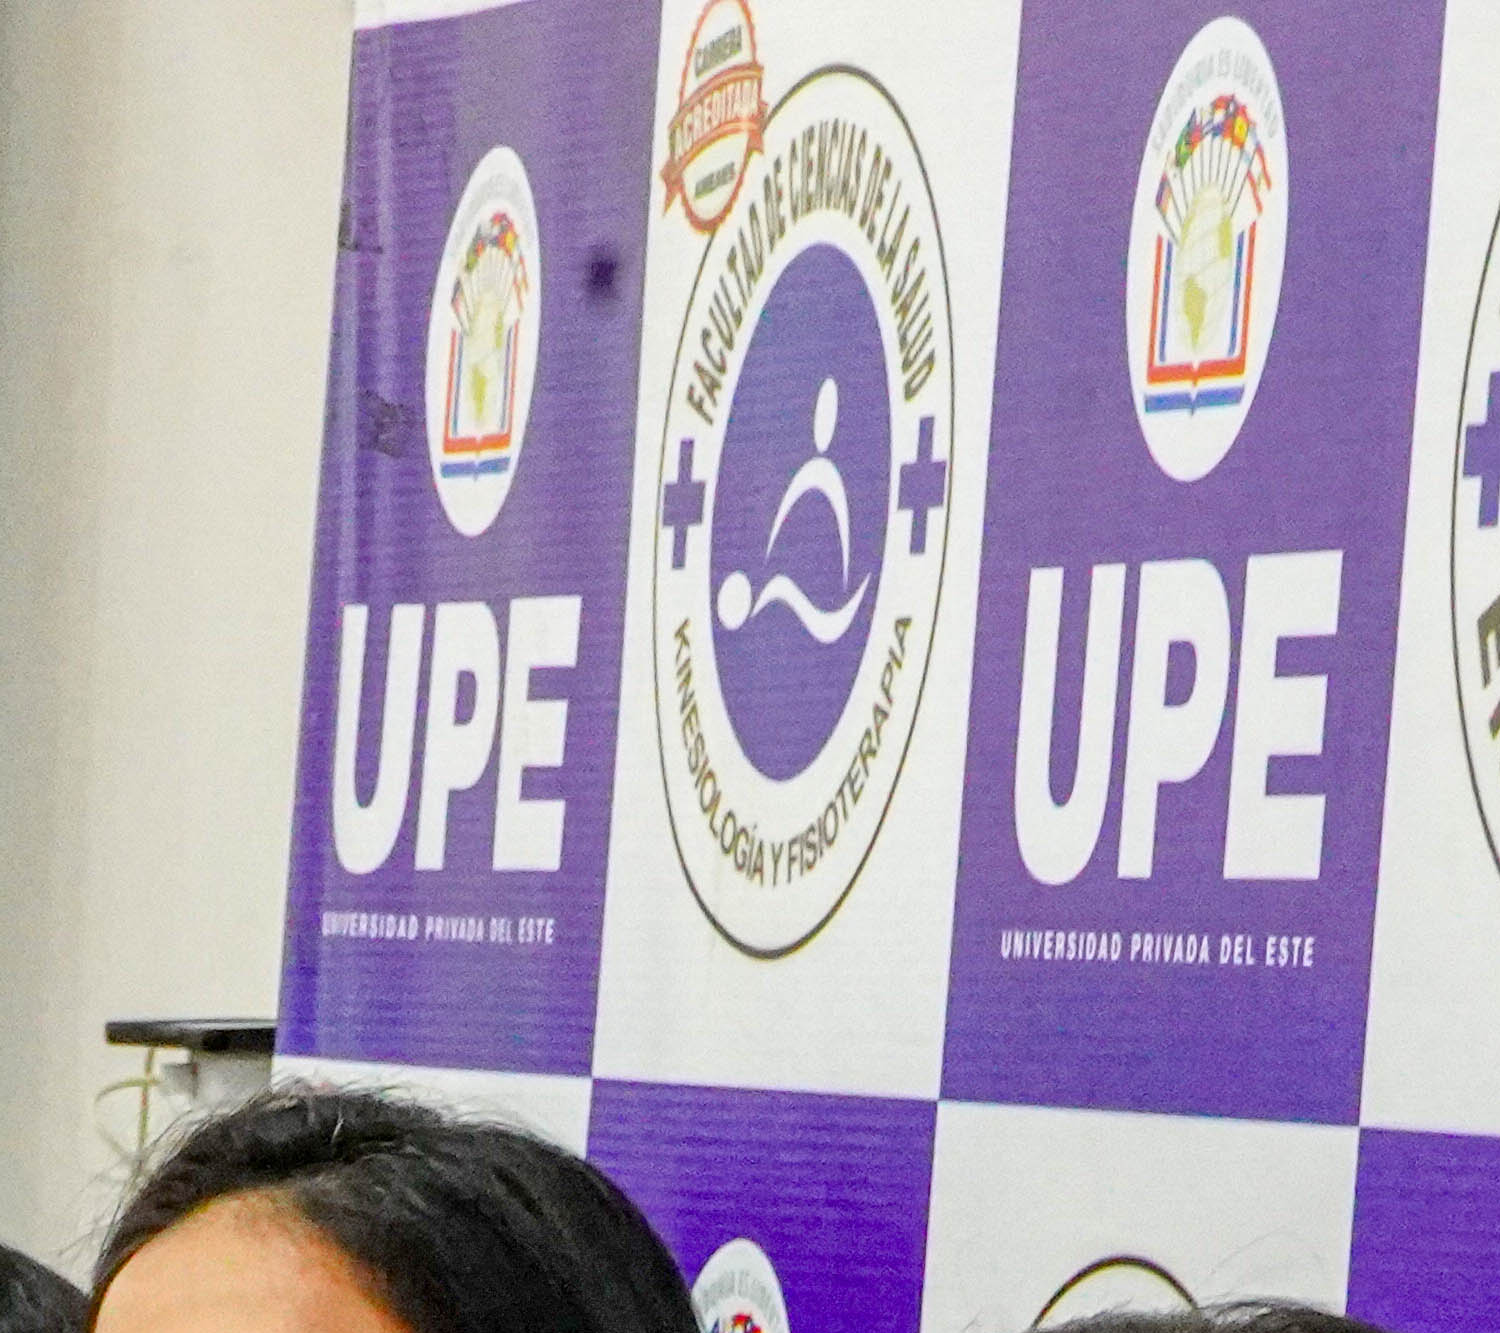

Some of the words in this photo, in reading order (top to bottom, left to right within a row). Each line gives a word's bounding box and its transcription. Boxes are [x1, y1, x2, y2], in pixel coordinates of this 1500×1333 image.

[764, 157, 785, 254] DE
[860, 144, 893, 242] DE
[878, 180, 910, 281] LA
[687, 202, 763, 425] FACULTAD
[892, 237, 935, 402] SALUD
[333, 596, 581, 873] UPE
[675, 619, 764, 887] KINESIOLOGÍA
[772, 842, 783, 887] Y
[1015, 551, 1342, 884] UPE
[322, 911, 418, 940] UNIVERSIDAD
[425, 916, 485, 942] PRIVADA
[489, 917, 513, 944] DEL
[518, 917, 555, 944] ESTE
[1000, 929, 1122, 960] UNIVERSIDAD
[1130, 933, 1210, 963] PRIVADA
[1219, 935, 1254, 965] DEL
[1265, 936, 1315, 967] ESTE
